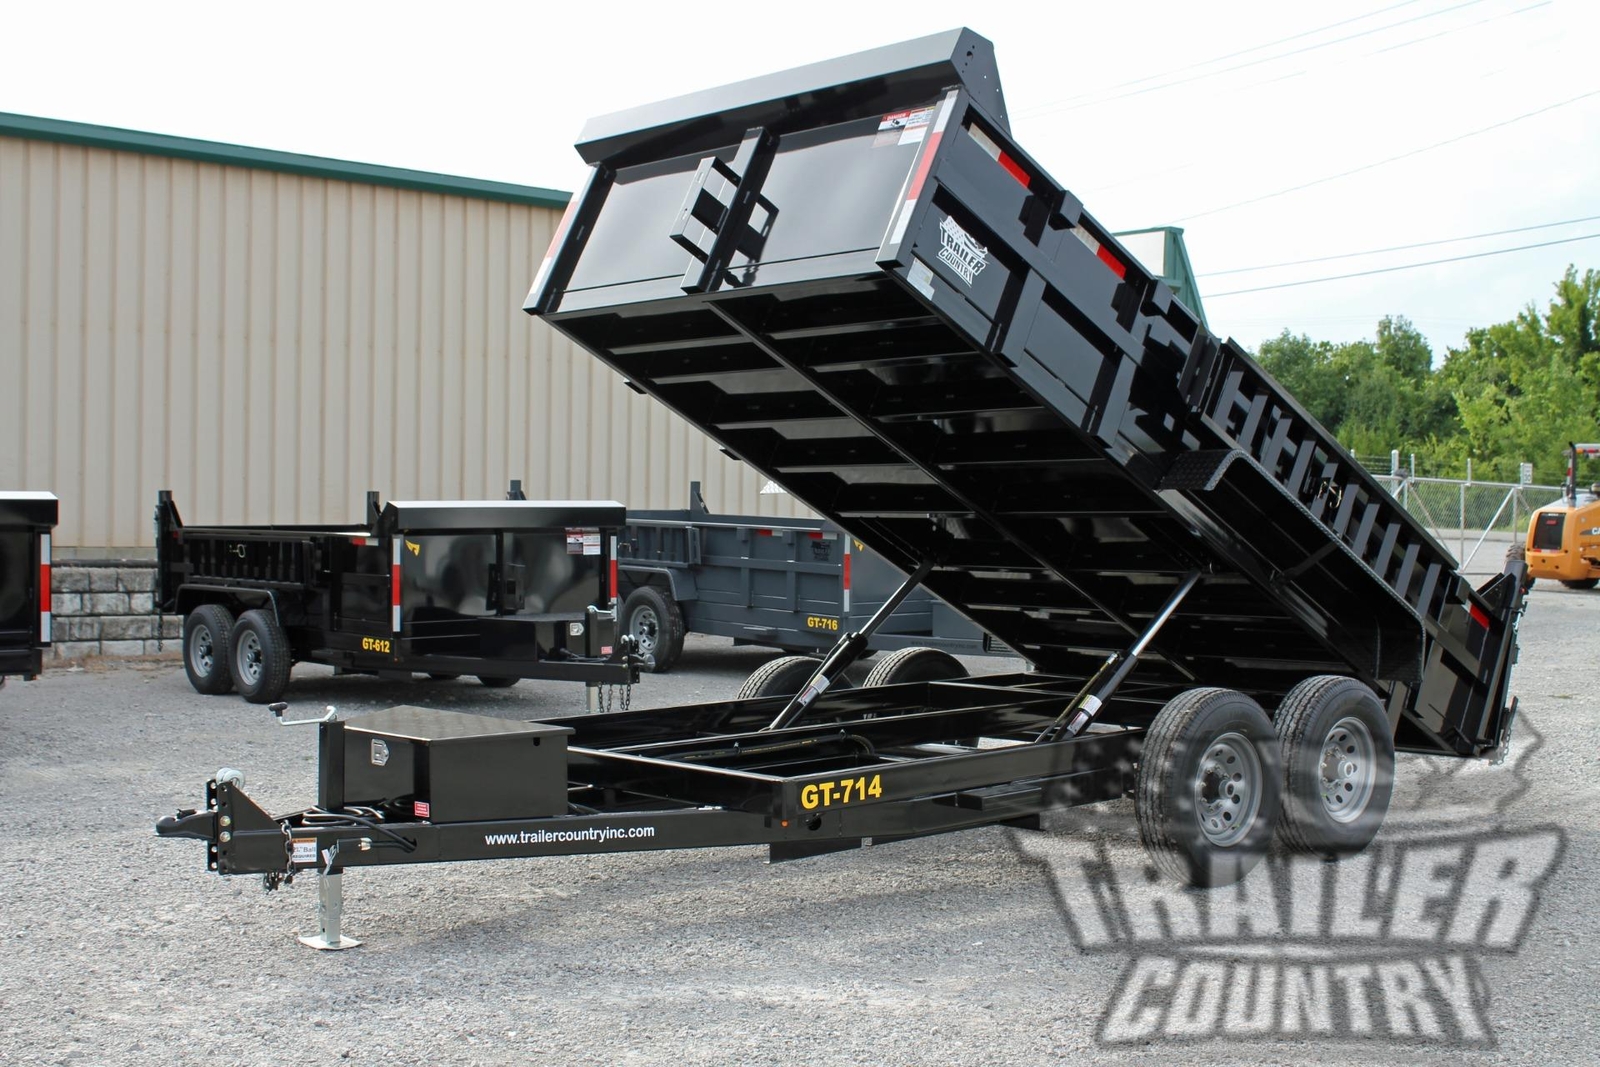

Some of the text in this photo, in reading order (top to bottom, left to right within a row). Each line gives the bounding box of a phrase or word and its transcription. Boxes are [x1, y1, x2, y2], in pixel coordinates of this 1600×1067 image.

[940, 225, 986, 274] TRAILER
[939, 248, 974, 283] COUNTRY
[806, 615, 839, 631] GT-716
[362, 637, 391, 654] GT-612
[800, 774, 882, 810] GT-714
[484, 824, 655, 847] www.trailercountryinc.com
